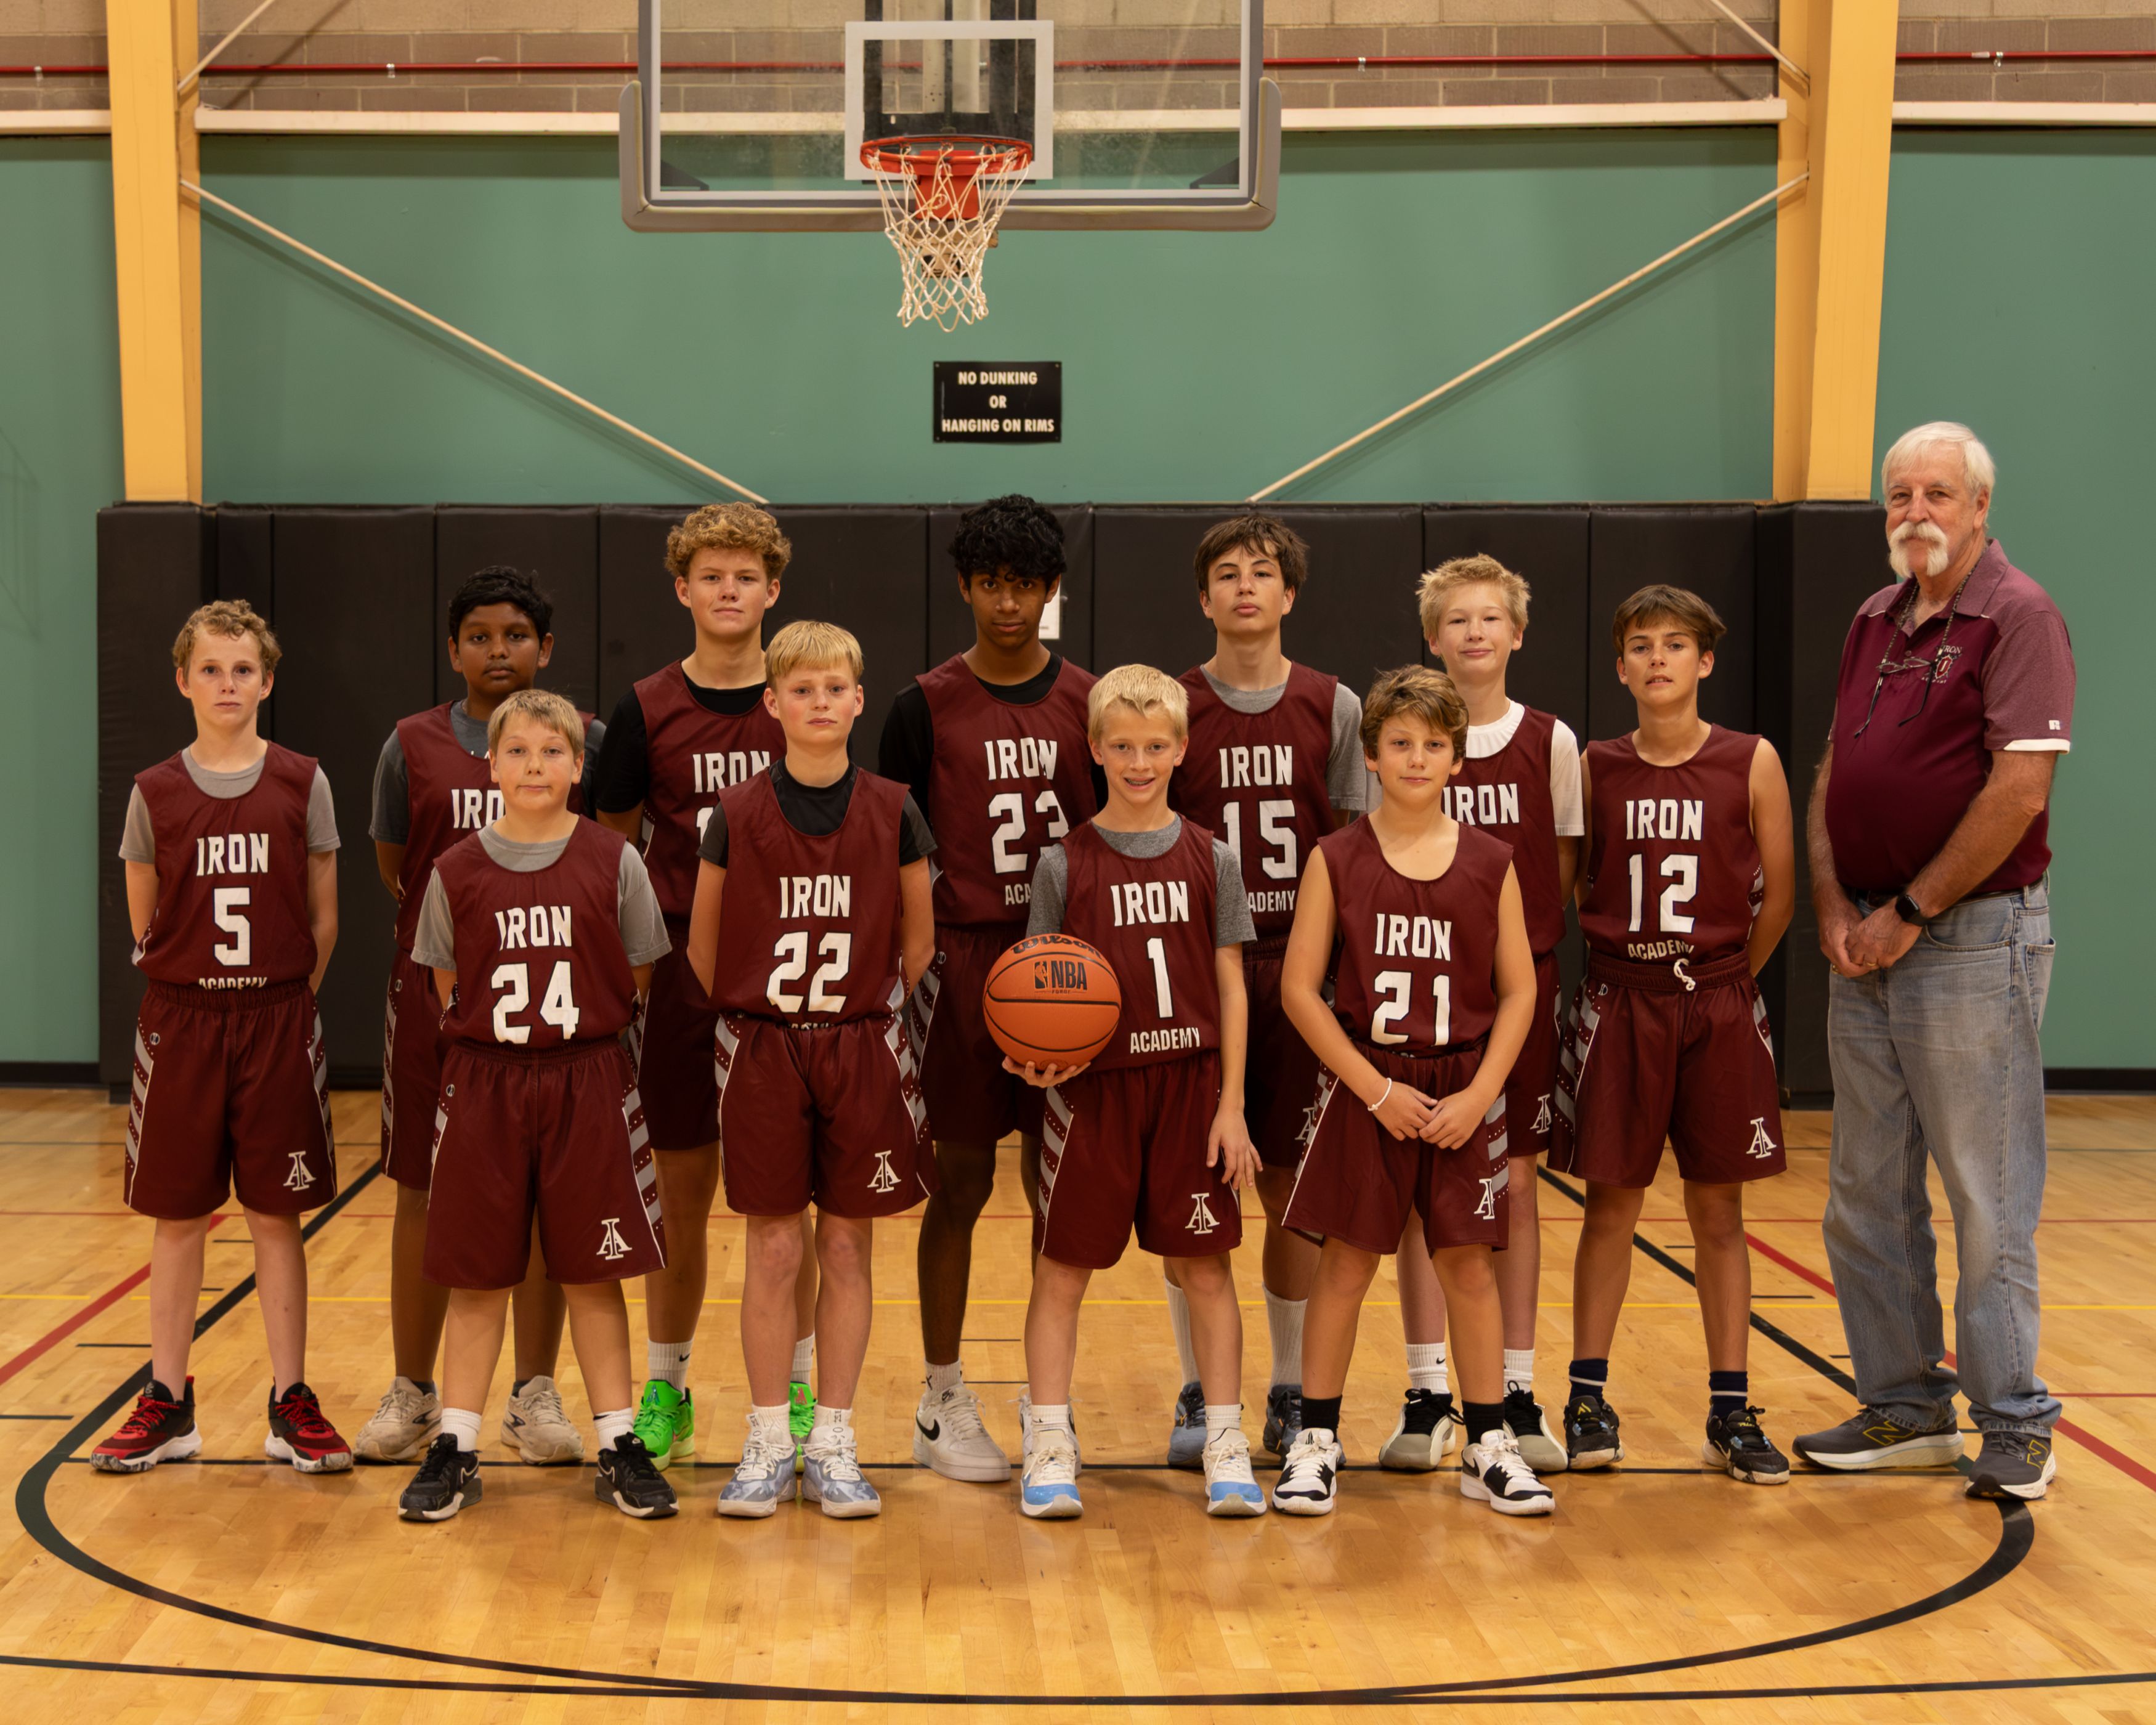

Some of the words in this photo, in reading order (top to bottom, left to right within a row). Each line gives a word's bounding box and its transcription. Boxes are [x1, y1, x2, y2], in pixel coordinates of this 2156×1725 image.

[958, 371, 977, 385] NO
[979, 371, 1038, 385] DUNKING
[989, 395, 1007, 408] OR
[941, 419, 1000, 432] HANGING
[1002, 419, 1021, 432] ON
[1024, 419, 1055, 432] RIMS
[984, 737, 1058, 781] IRON
[1219, 744, 1293, 788] IRON
[451, 789, 505, 829] IRO
[1443, 783, 1520, 826] IRON
[1626, 799, 1703, 841] IRON
[196, 833, 269, 877] IRON
[1223, 800, 1297, 879] 15
[779, 874, 851, 919] IRON
[1110, 880, 1189, 927] IRON
[1248, 890, 1295, 912] ADEMY
[1628, 853, 1699, 933] 12
[213, 887, 251, 966] 5
[495, 905, 572, 951] IRON
[1011, 935, 1104, 960] Wilson
[1374, 913, 1452, 962] IRON
[766, 931, 852, 1013] 22
[1051, 960, 1088, 991] NBA
[1146, 937, 1173, 1019] 1
[491, 960, 580, 1045] 24
[1371, 970, 1450, 1047] 21
[1130, 1027, 1201, 1054] ACADEMY
